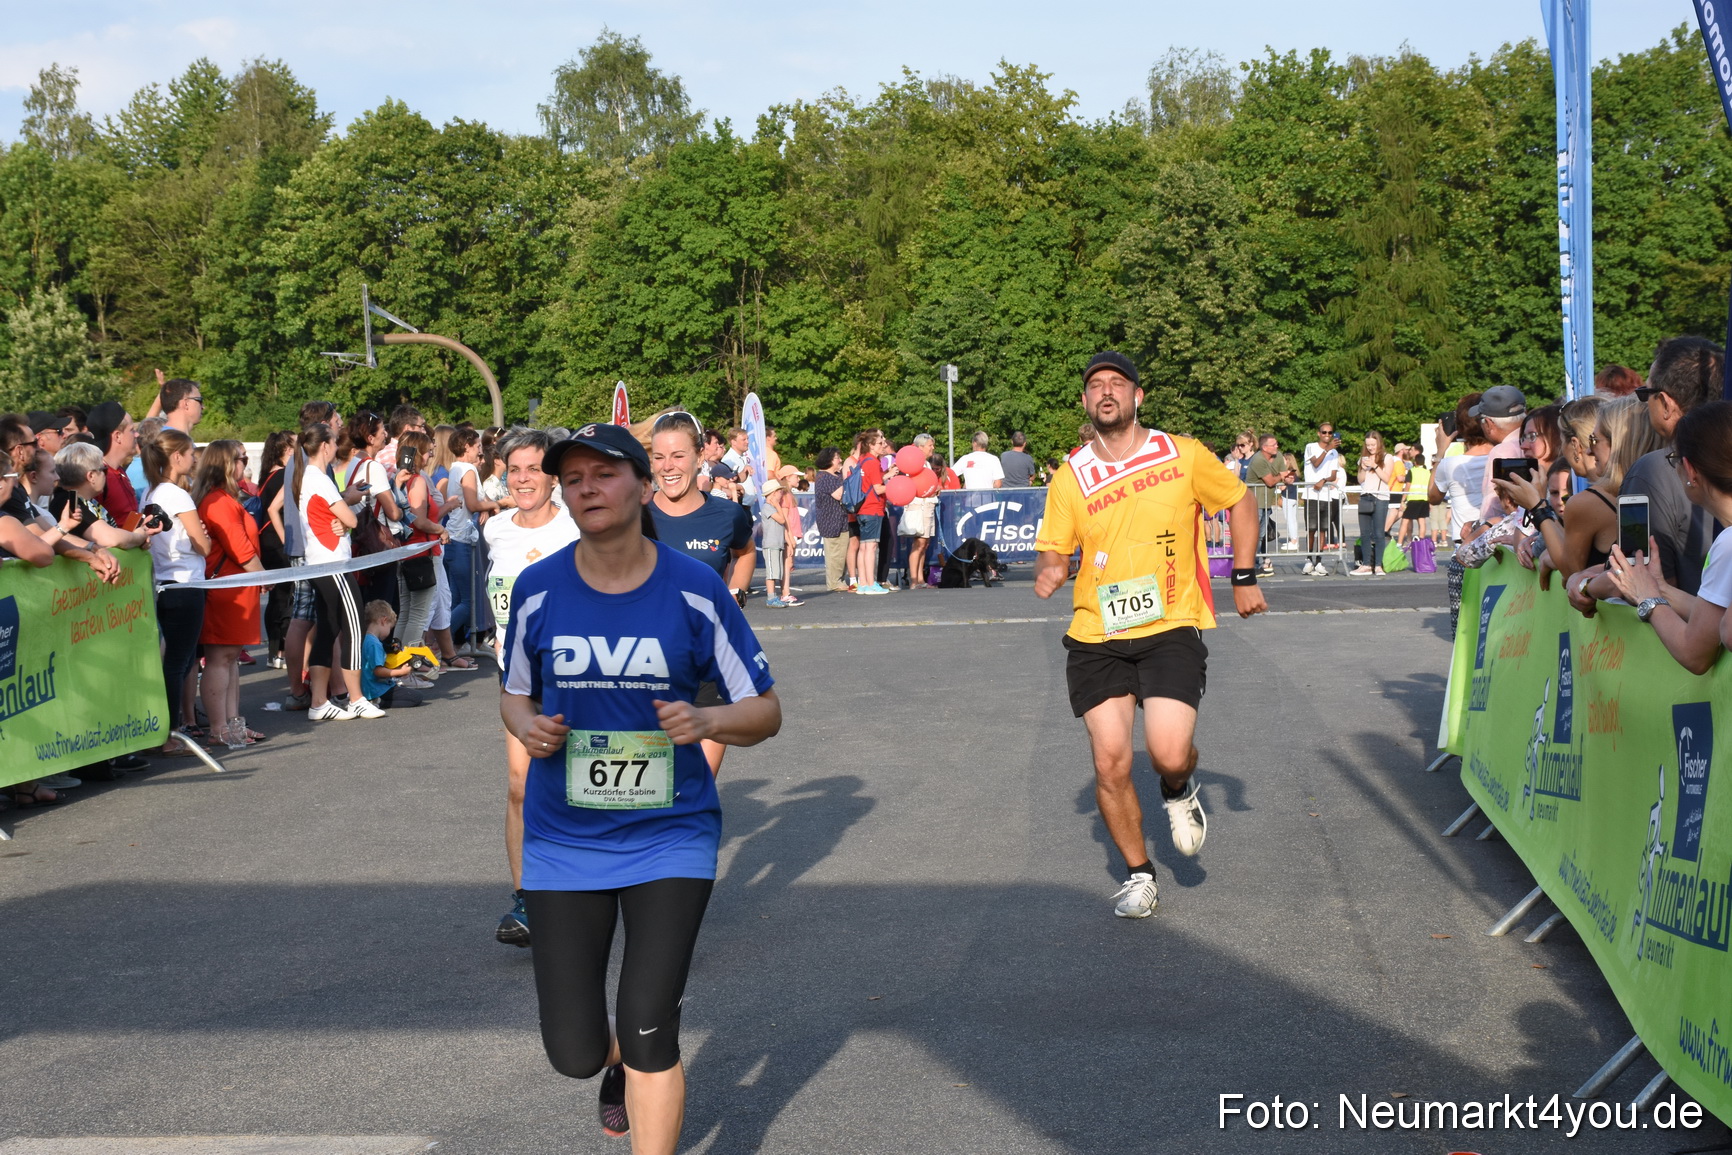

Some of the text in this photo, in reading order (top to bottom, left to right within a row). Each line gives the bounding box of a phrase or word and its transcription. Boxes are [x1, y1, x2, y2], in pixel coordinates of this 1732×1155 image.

[1087, 466, 1185, 516] MAX BÖGL
[686, 539, 708, 550] vhs
[1156, 529, 1176, 605] maxfit
[51, 571, 98, 616] Gesunde
[1107, 592, 1154, 617] 1705
[70, 588, 148, 645] laufen länger!
[552, 635, 670, 678] DVA
[568, 681, 618, 689] FURTHER.
[620, 682, 671, 691] TOGETHER
[648, 751, 667, 759] 2019
[1684, 752, 1707, 778] Fischer
[589, 760, 649, 787] 677
[583, 788, 656, 796] Kurzdörfer Sabine
